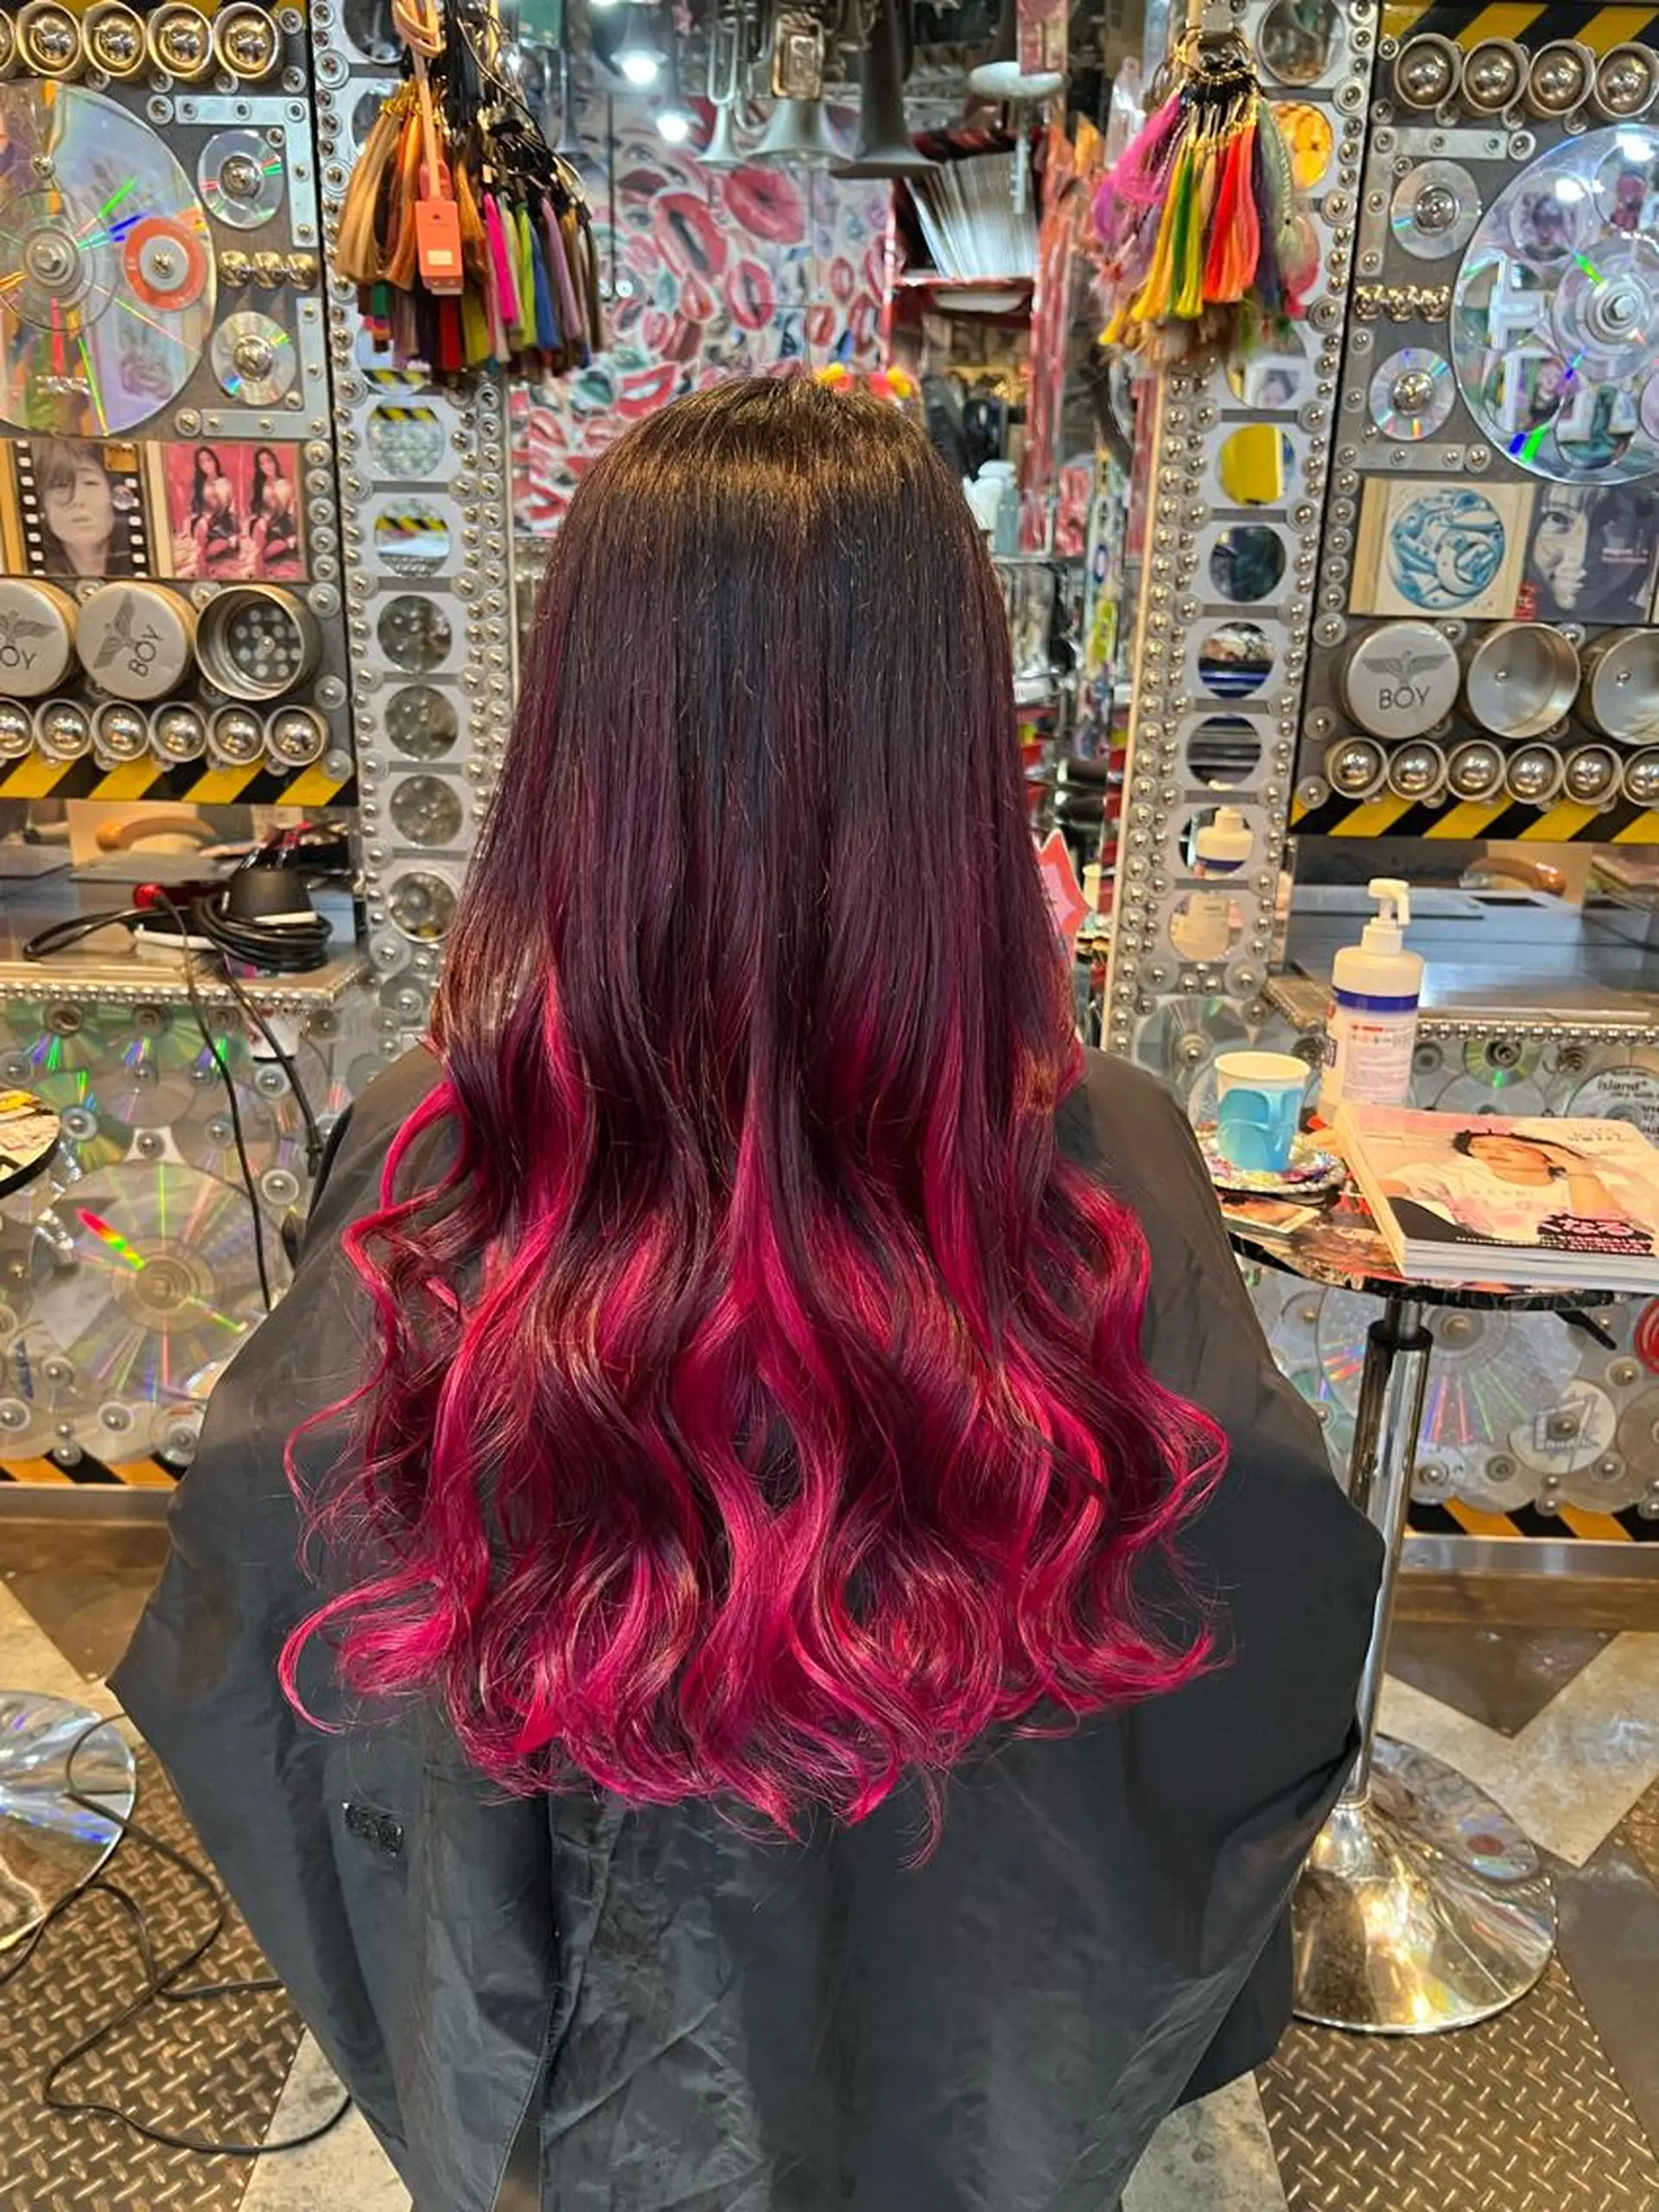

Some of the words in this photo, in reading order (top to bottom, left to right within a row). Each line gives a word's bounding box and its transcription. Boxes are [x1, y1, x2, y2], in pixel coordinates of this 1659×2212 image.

[0, 645, 37, 671] OY
[127, 623, 164, 678] BOY
[1378, 684, 1432, 710] BOY
